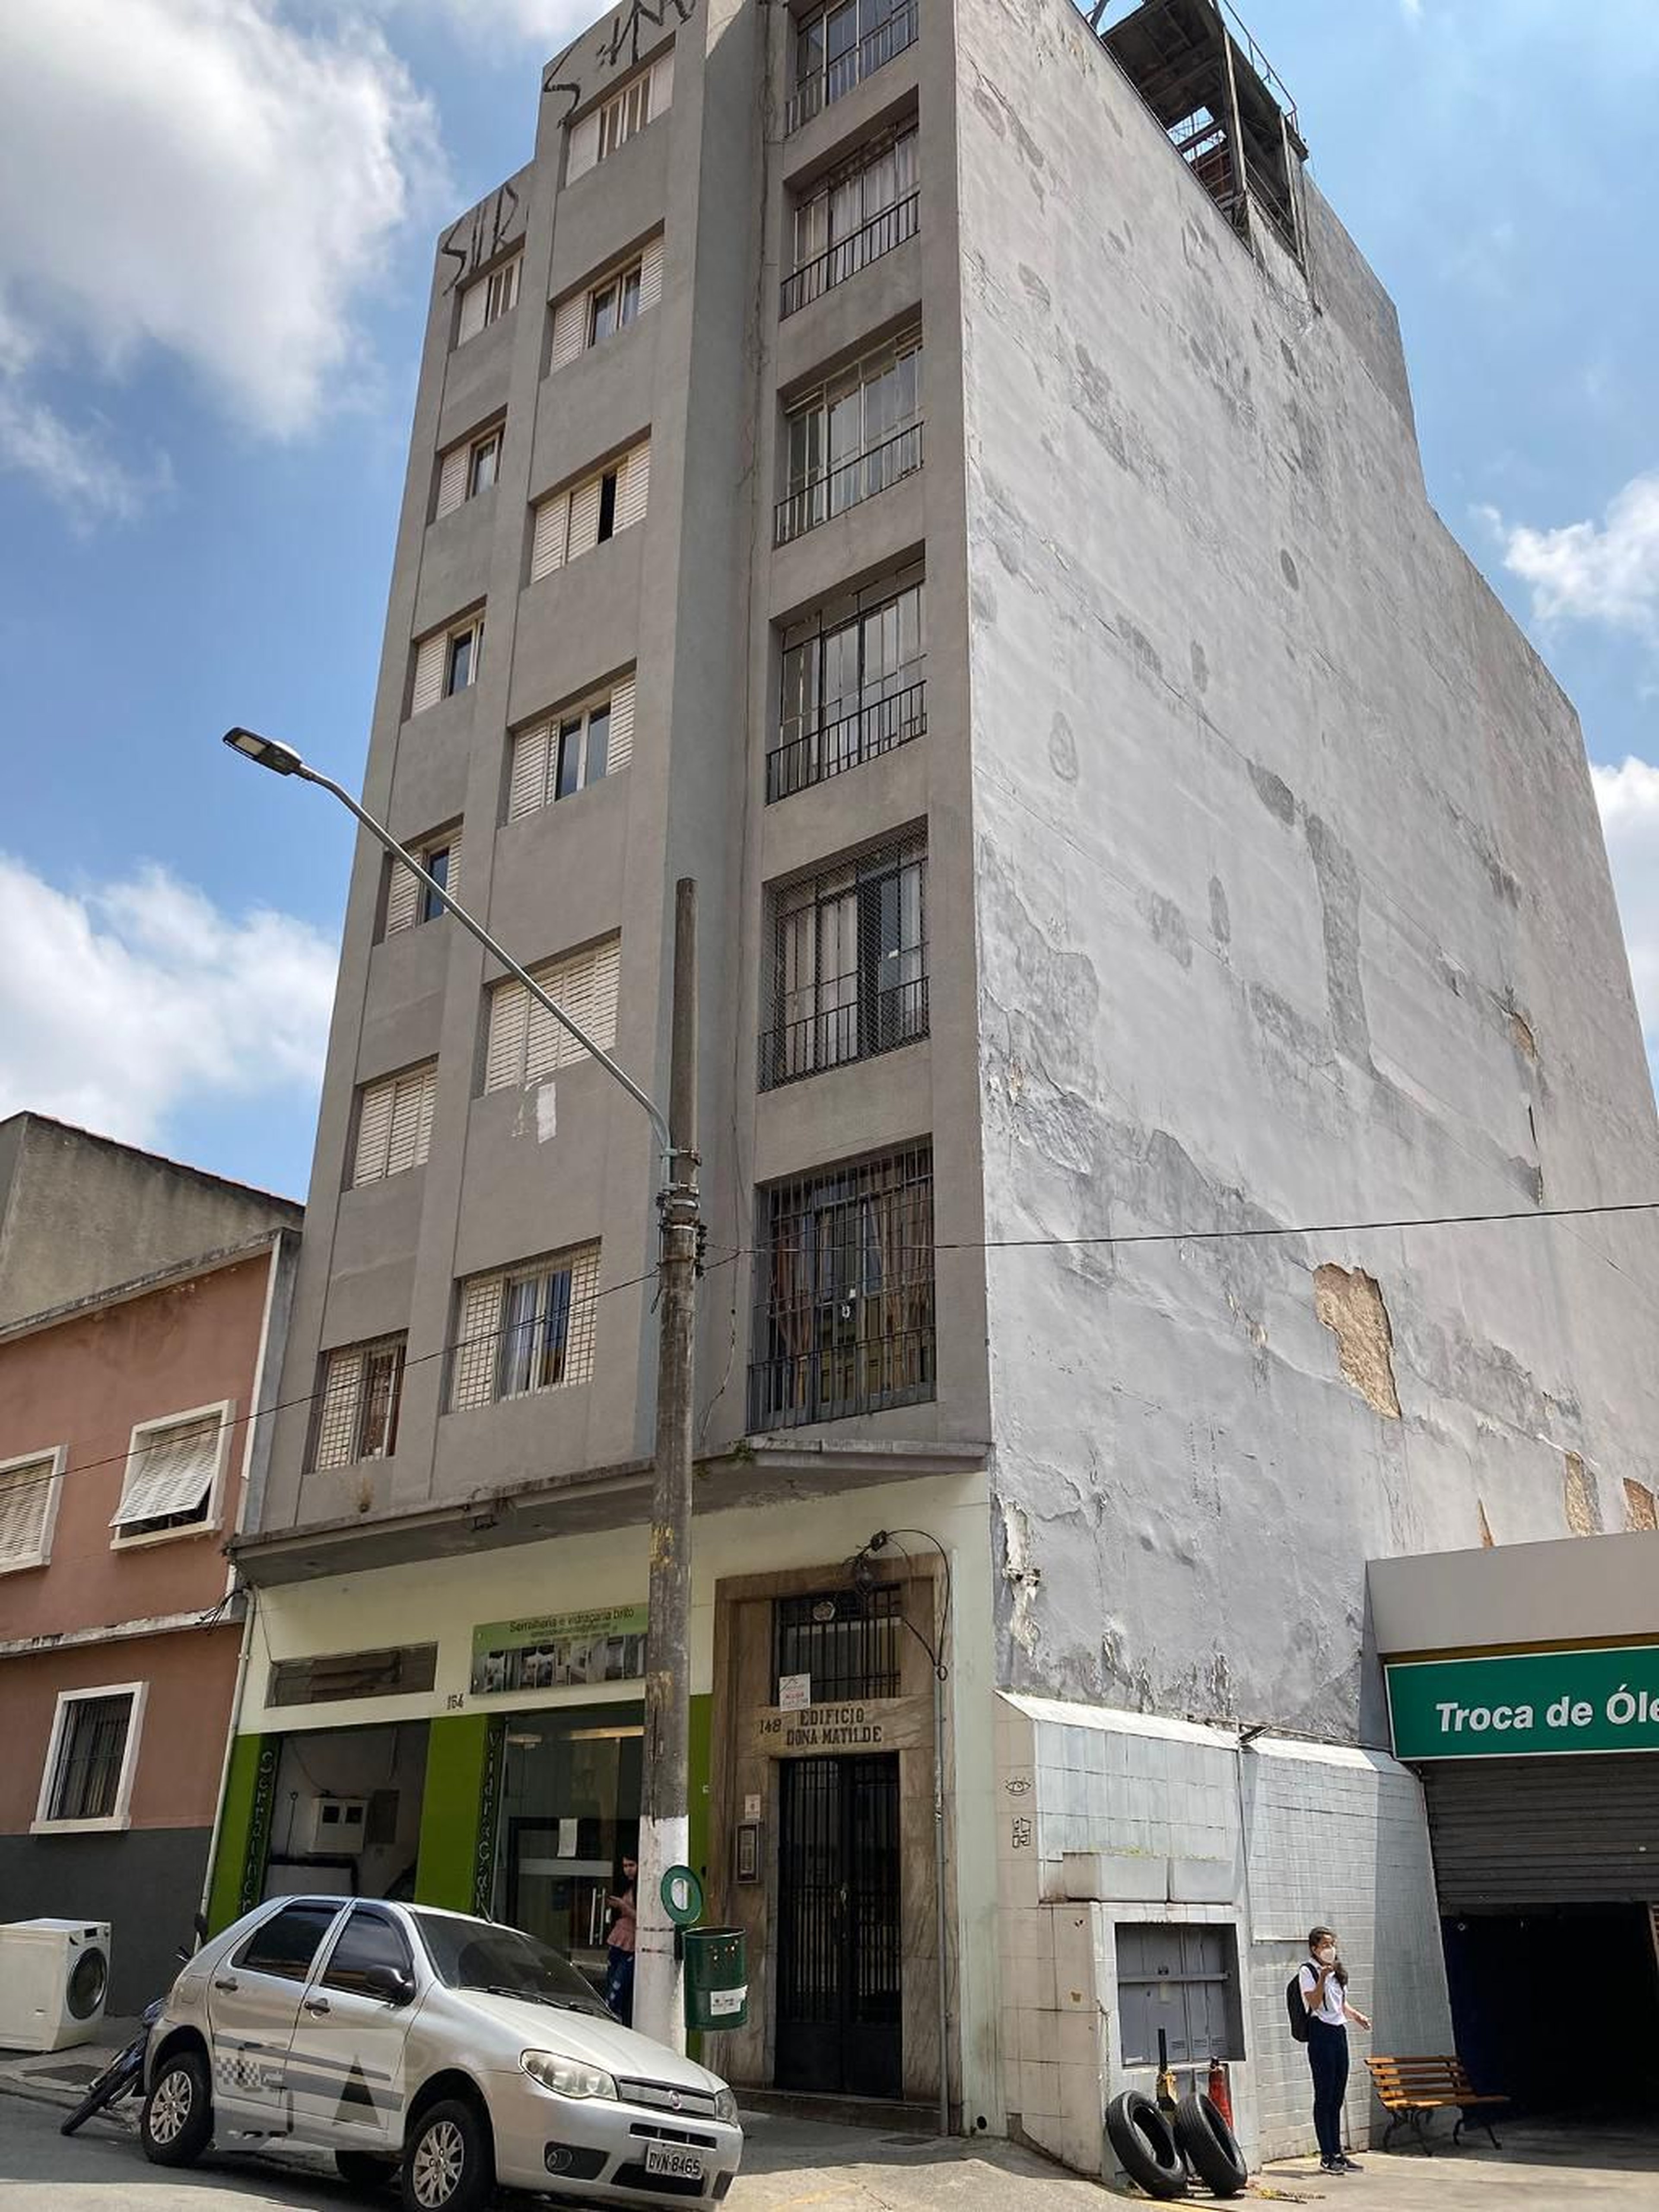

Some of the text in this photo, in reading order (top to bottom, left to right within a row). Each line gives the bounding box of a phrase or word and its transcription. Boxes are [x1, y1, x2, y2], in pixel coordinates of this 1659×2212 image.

[799, 1707, 864, 1726] EDIFICIO
[1436, 1703, 1534, 1732] Troca
[1546, 1696, 1593, 1727] de
[760, 1718, 782, 1735] 148
[786, 1726, 882, 1746] DONA MATILDE
